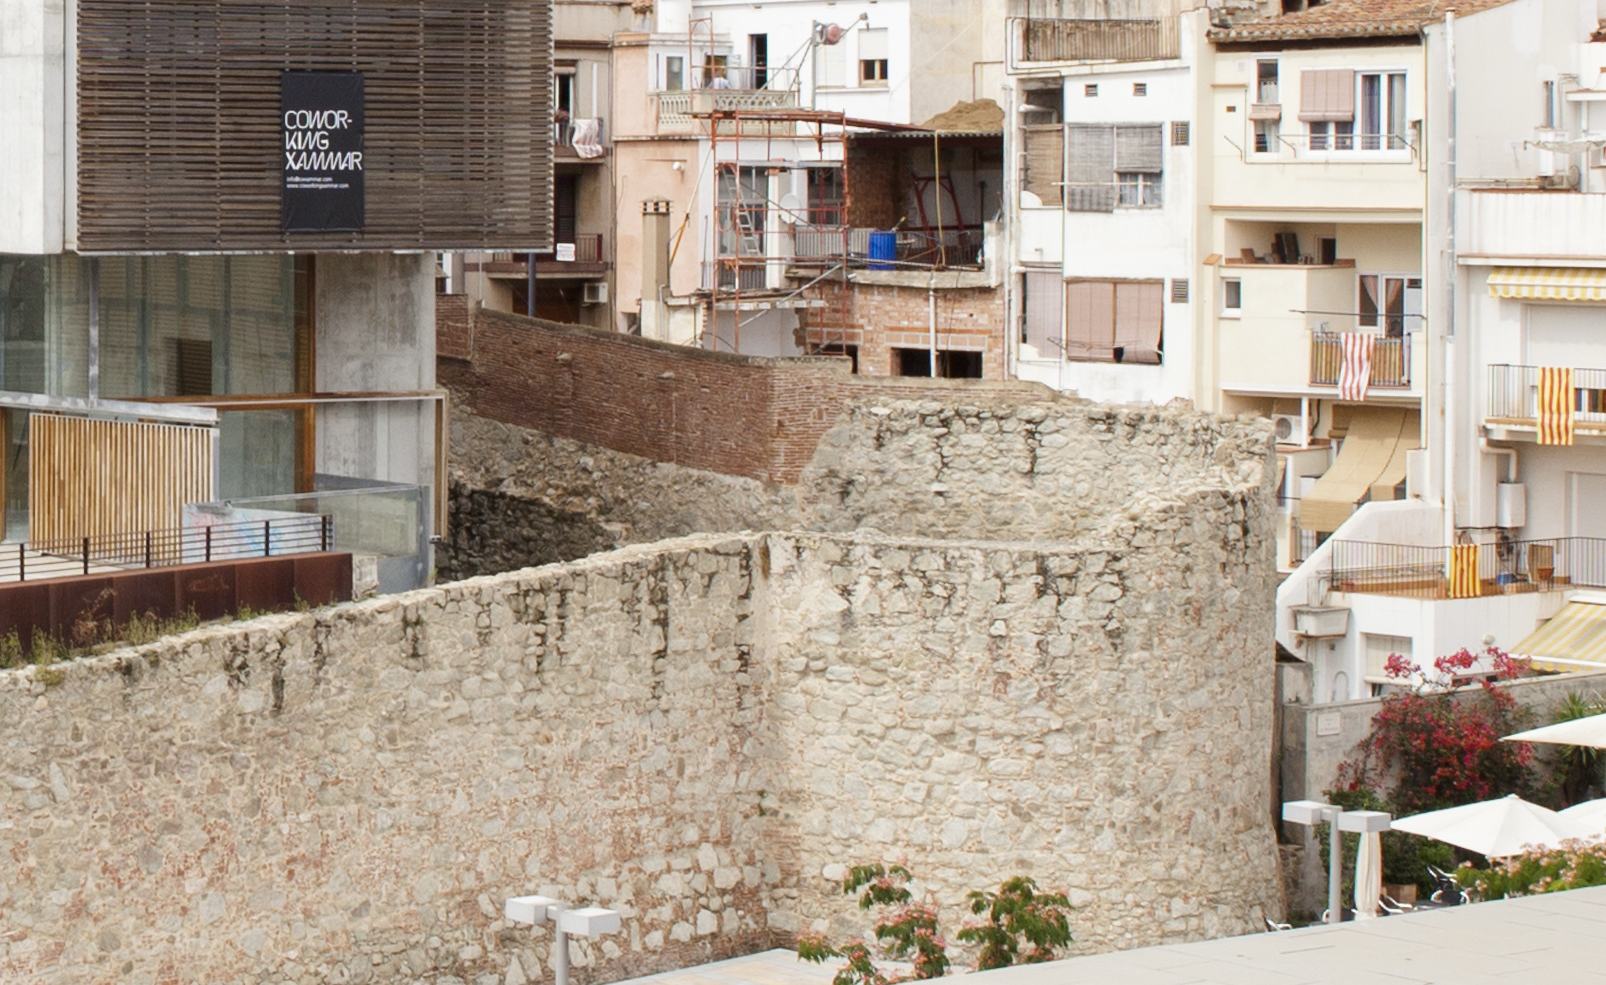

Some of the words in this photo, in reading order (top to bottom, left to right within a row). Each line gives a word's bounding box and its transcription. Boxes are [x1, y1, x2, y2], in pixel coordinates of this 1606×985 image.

[284, 110, 353, 130] COWOR-
[285, 131, 330, 150] KING
[285, 151, 363, 171] XAMMAR
